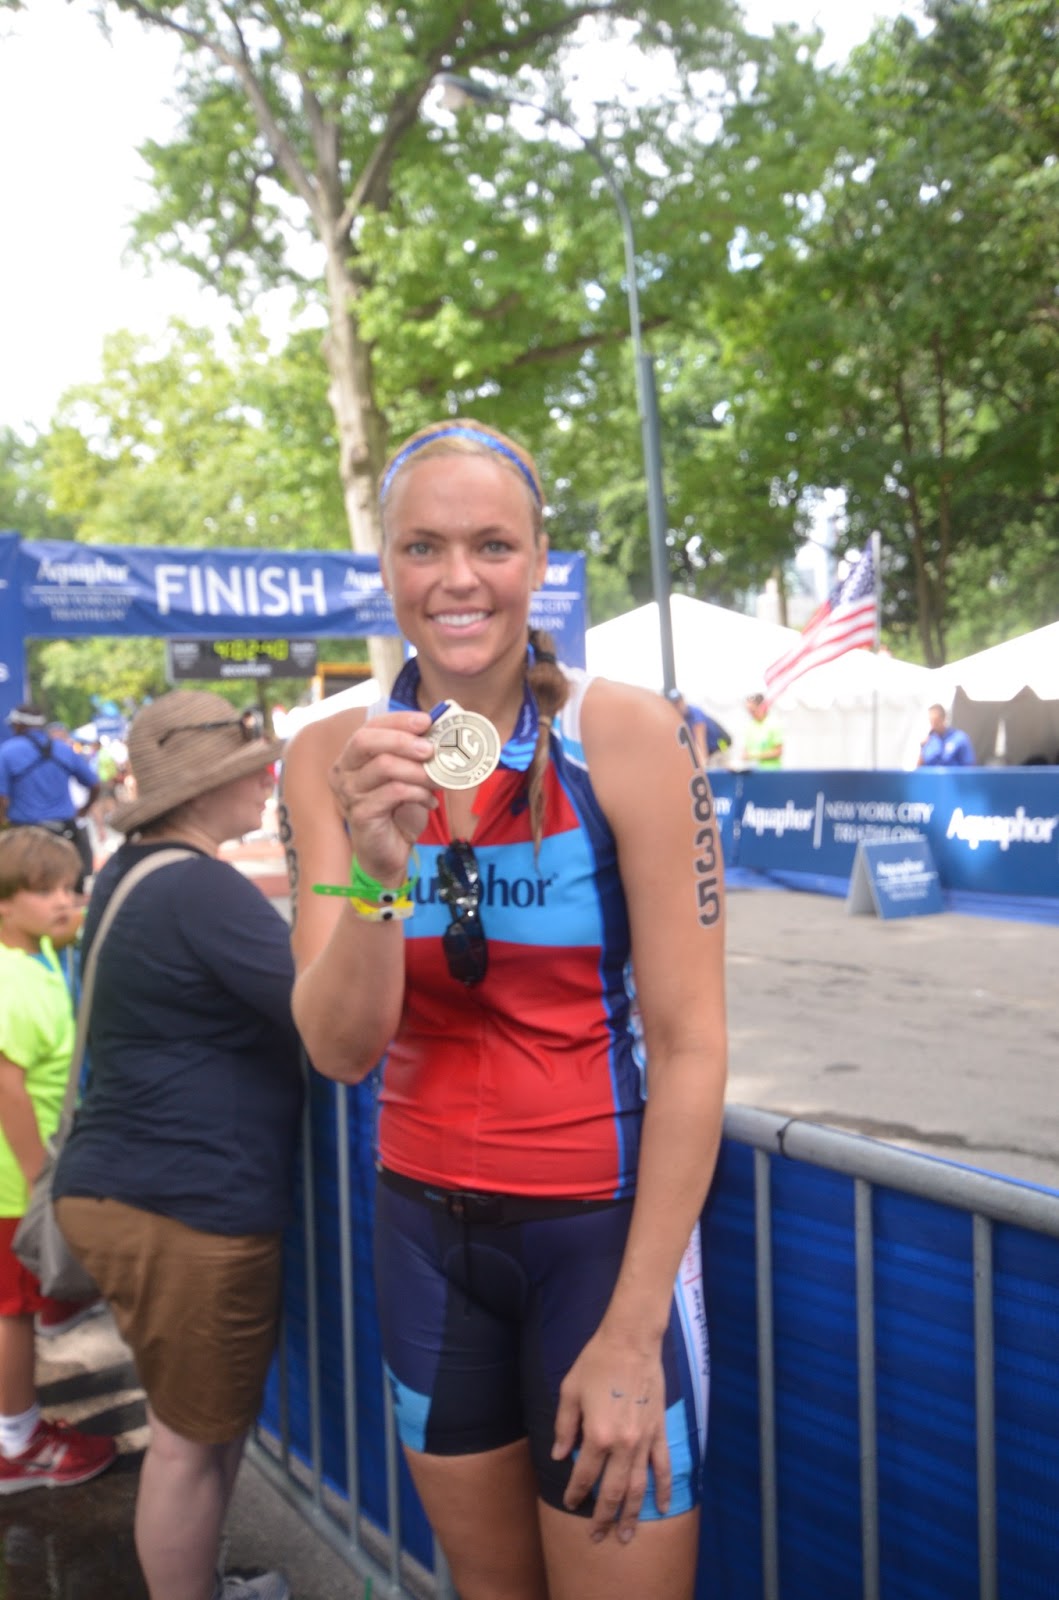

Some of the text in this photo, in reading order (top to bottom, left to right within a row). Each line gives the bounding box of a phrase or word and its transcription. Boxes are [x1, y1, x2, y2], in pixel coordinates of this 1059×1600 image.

[154, 563, 328, 617] FINISH
[679, 726, 720, 926] 1835
[742, 799, 816, 838] Aquaphor
[824, 801, 935, 825] NEW YORK CITY
[946, 805, 1058, 851] Aquaphor
